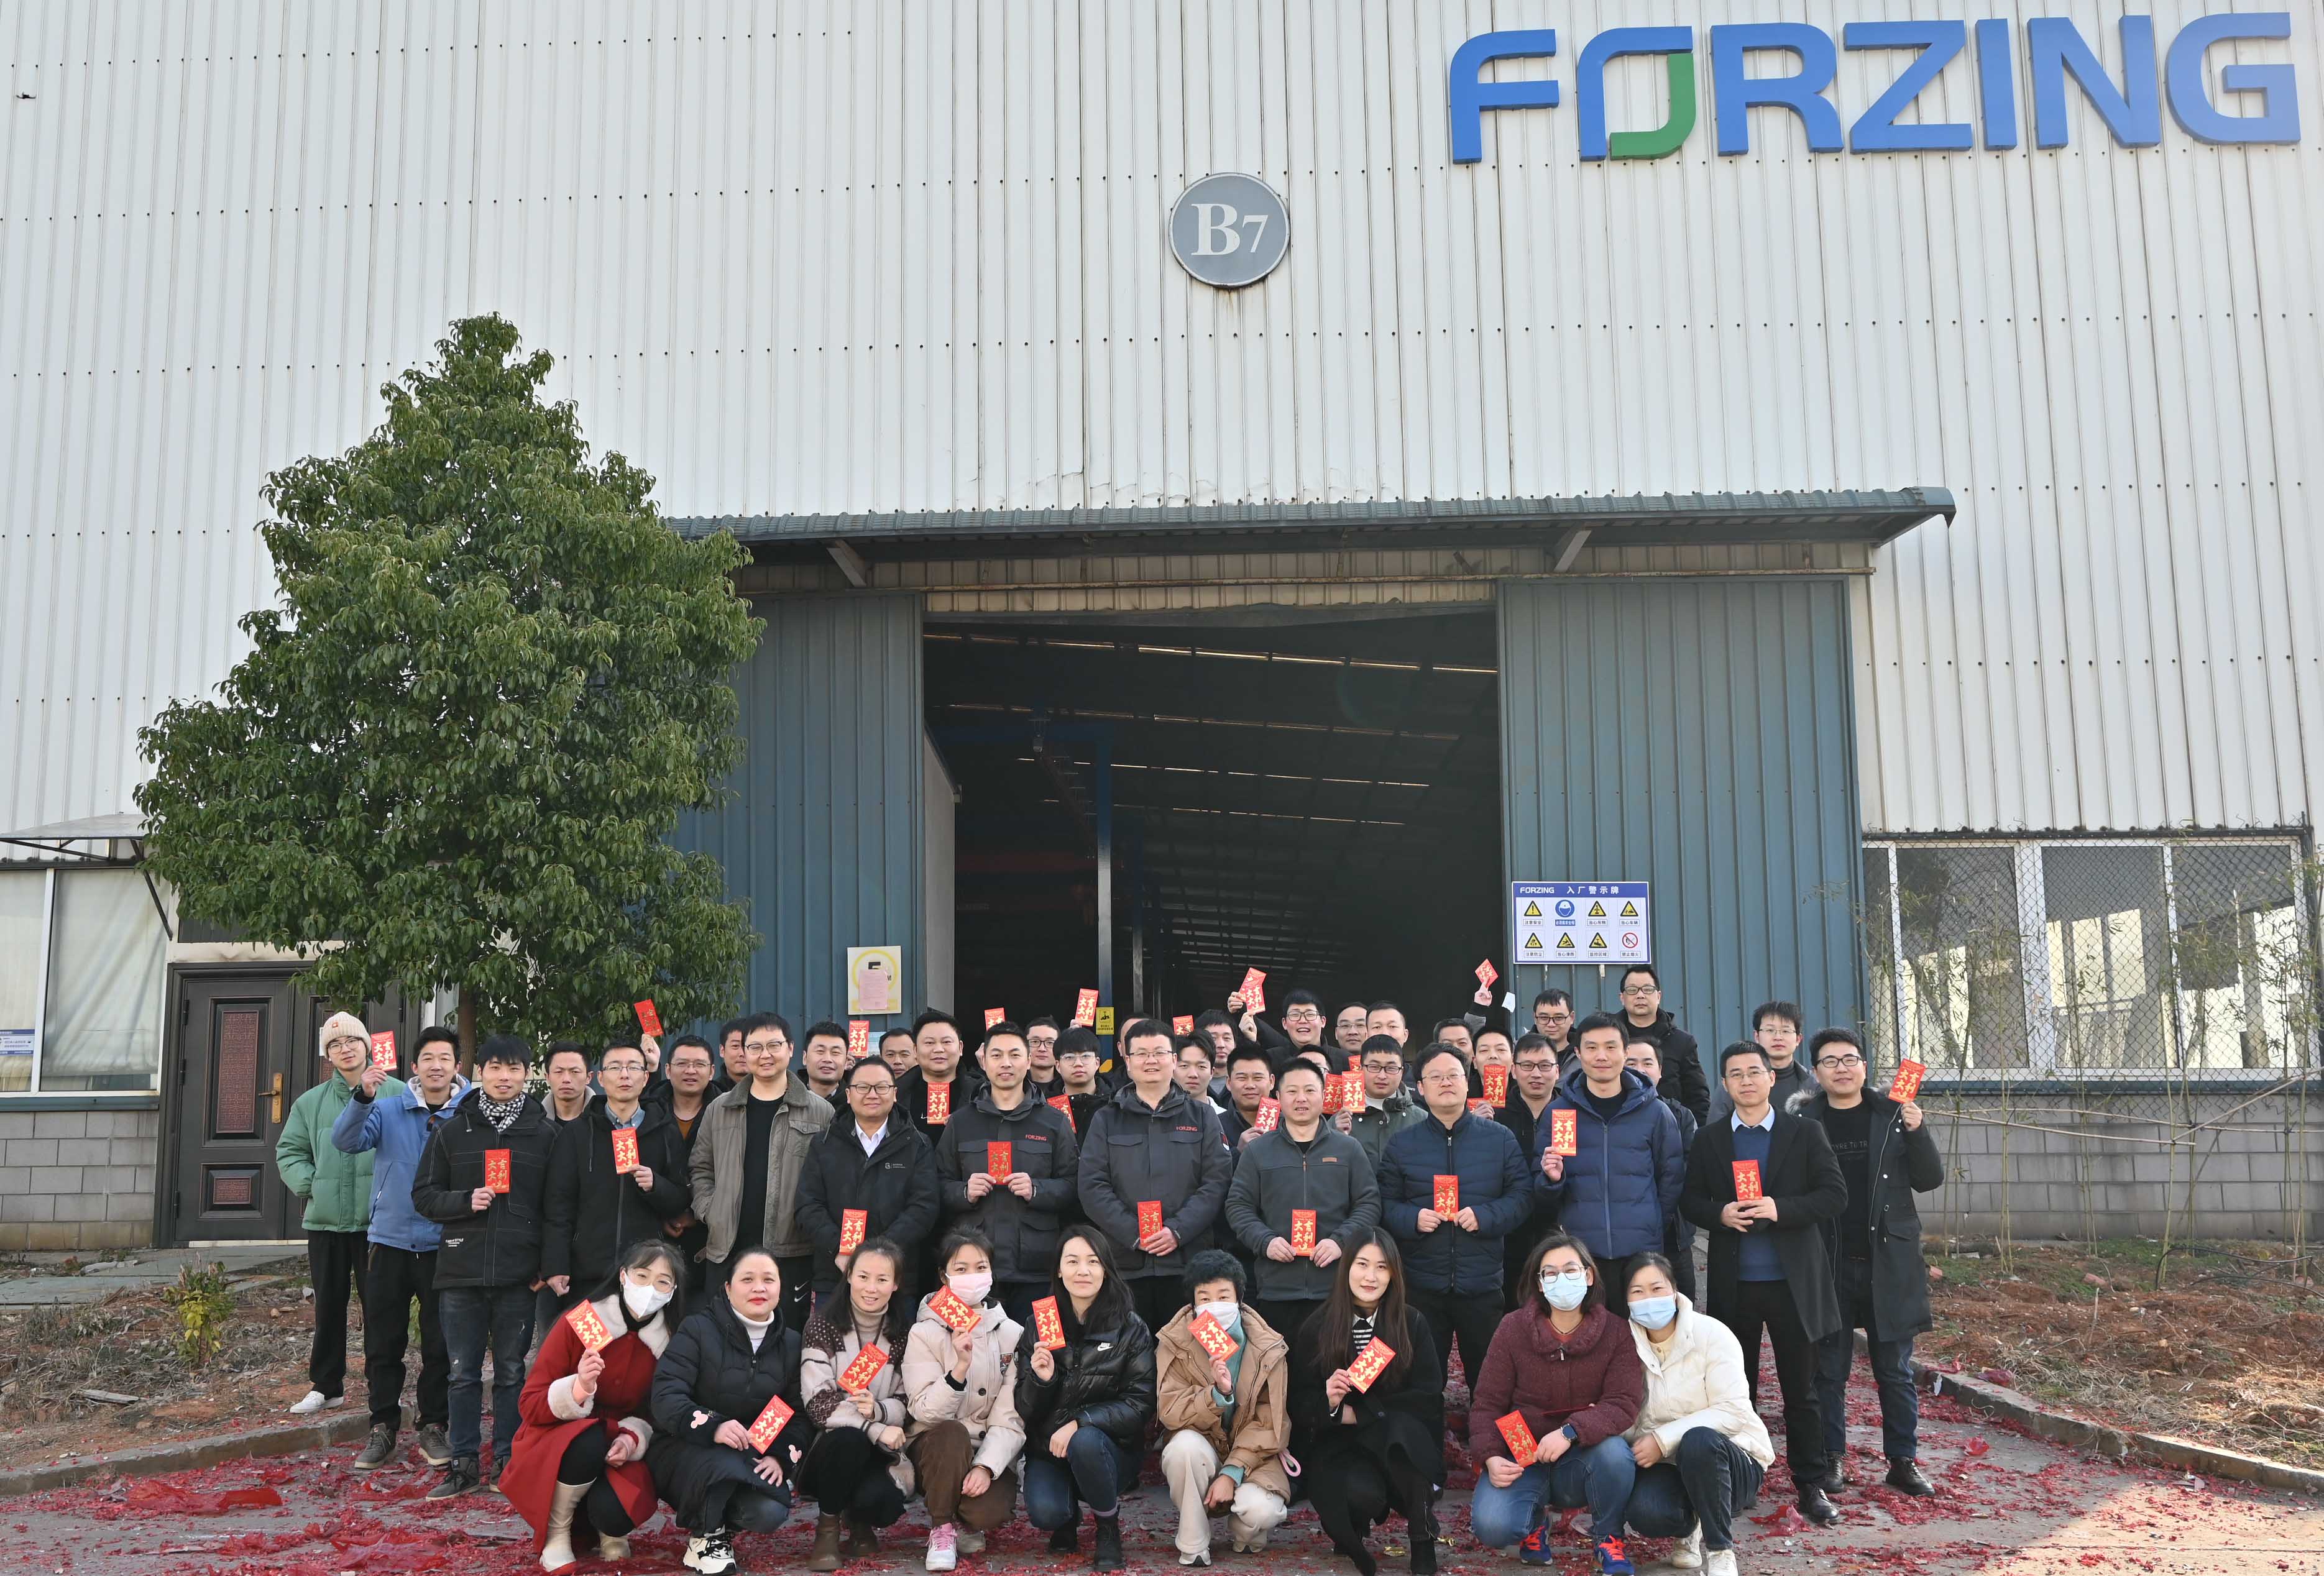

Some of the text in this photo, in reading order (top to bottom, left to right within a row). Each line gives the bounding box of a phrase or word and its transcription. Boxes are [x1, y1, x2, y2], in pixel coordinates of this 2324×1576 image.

[1449, 11, 2301, 164] FORZING
[1191, 203, 1269, 255] B7
[1566, 886, 1620, 894] 入厂警示牌
